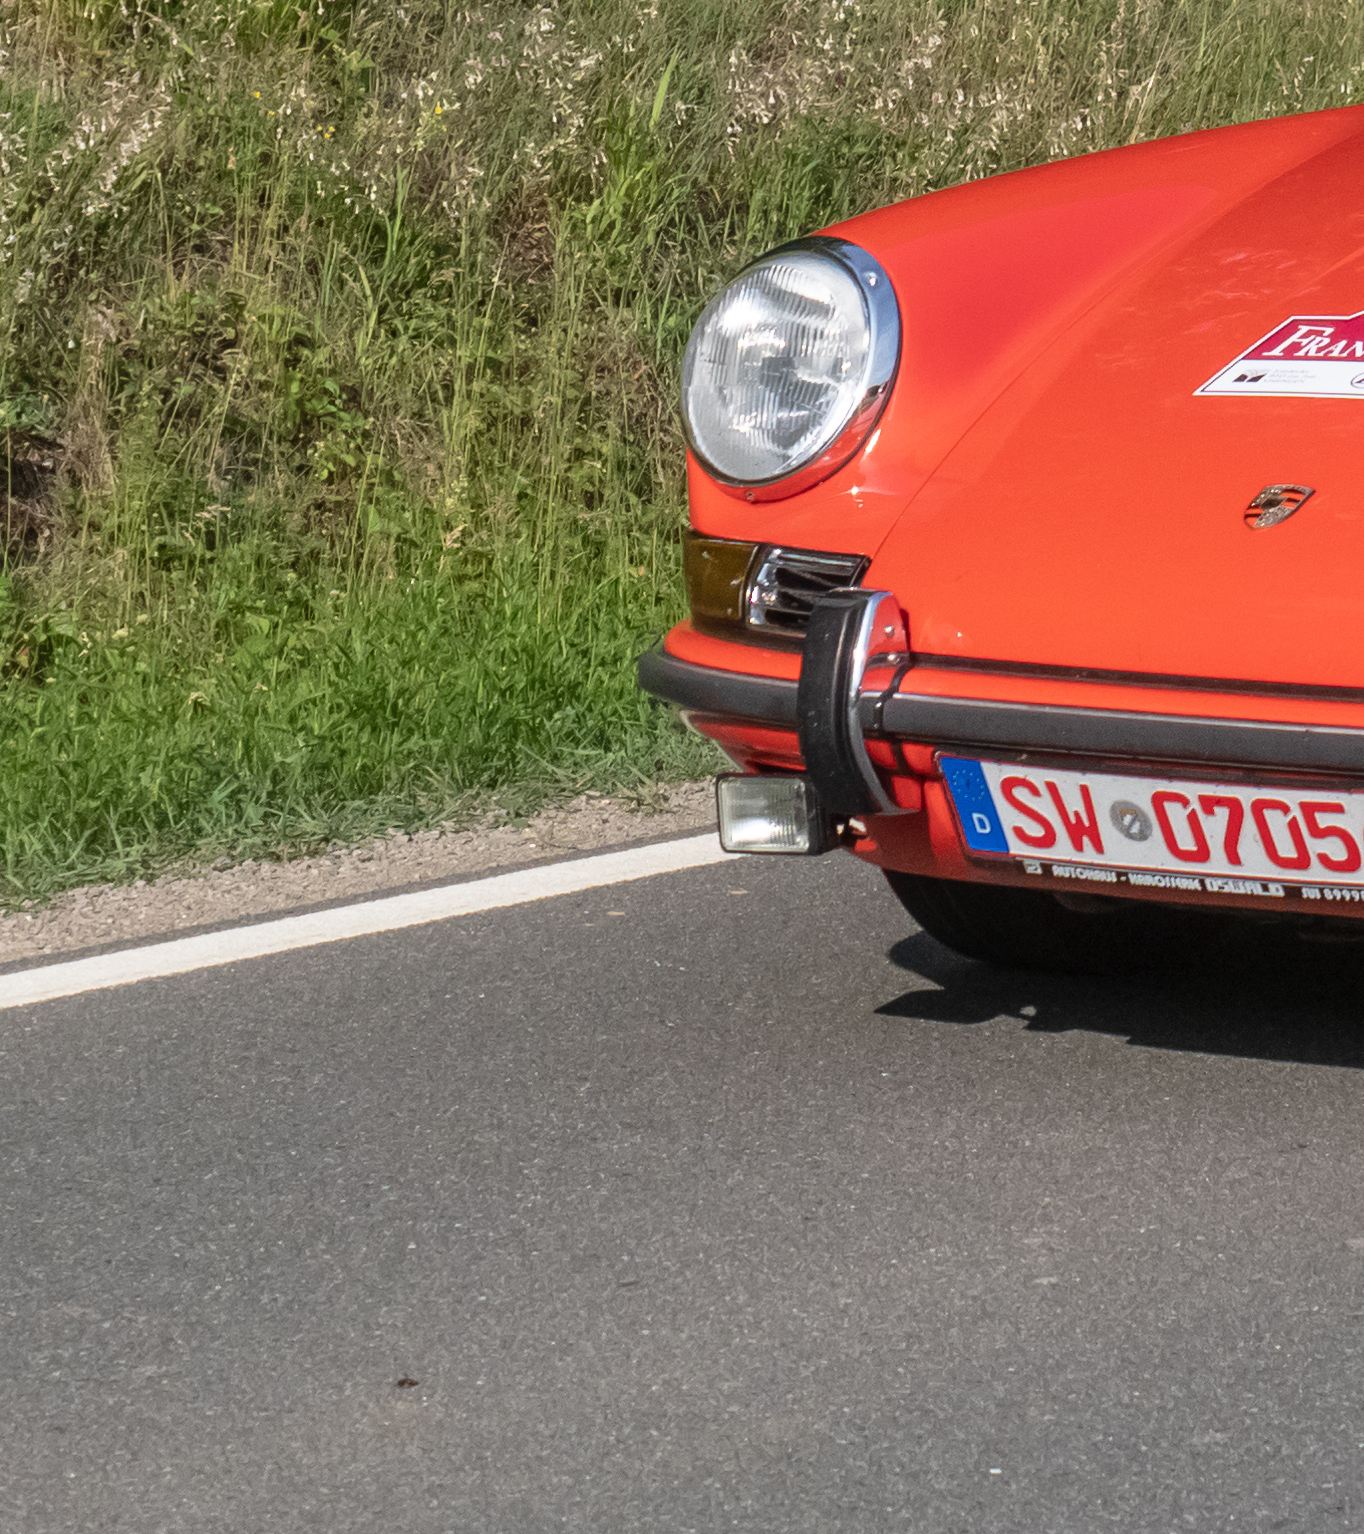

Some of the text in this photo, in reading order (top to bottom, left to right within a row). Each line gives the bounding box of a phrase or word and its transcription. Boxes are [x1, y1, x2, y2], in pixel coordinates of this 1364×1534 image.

[972, 812, 991, 834] D
[1000, 776, 1105, 855] SW
[1052, 864, 1118, 883] AUTOHAUS
[1205, 877, 1286, 898] OSWALD
